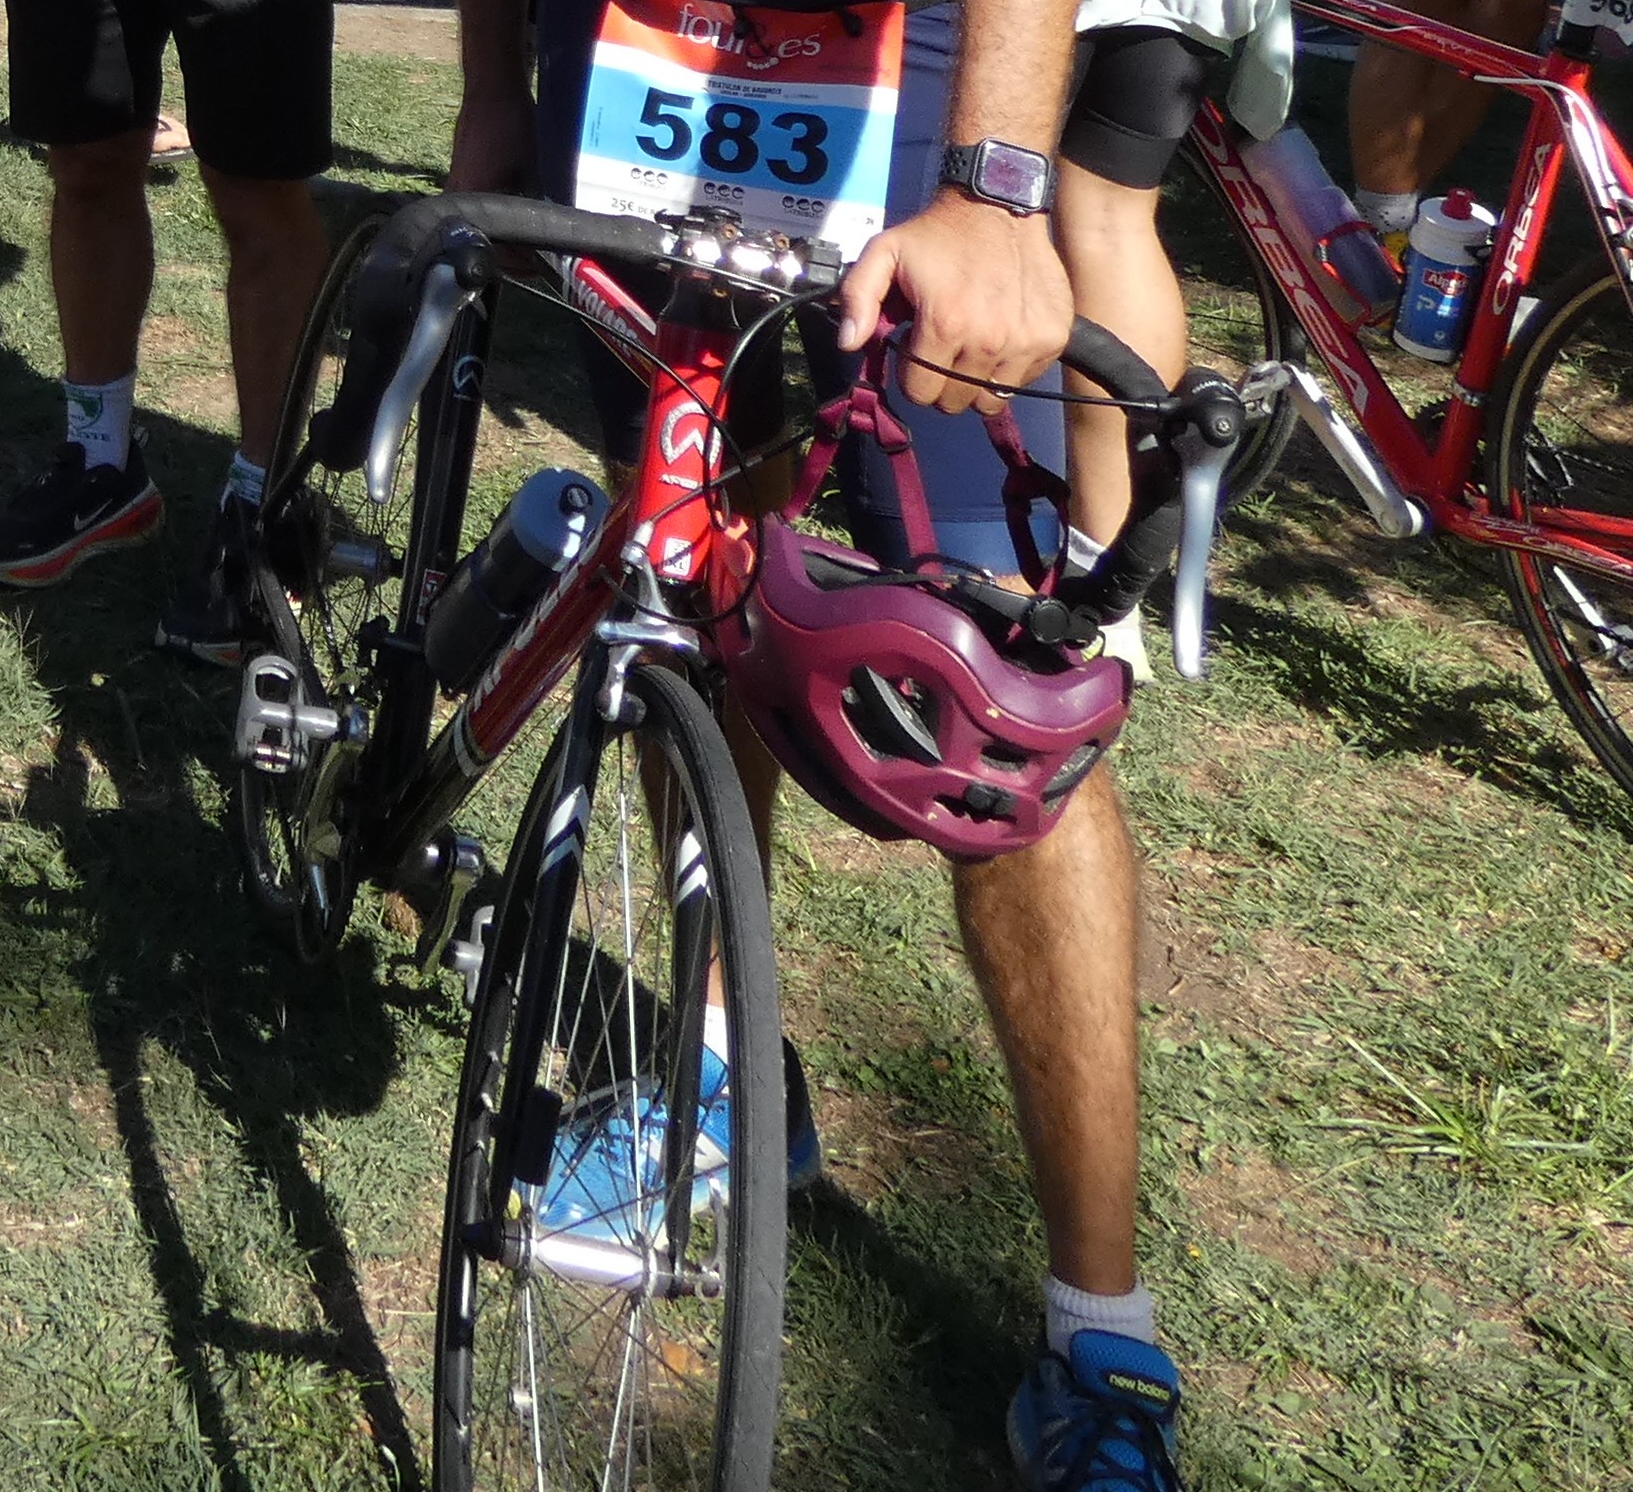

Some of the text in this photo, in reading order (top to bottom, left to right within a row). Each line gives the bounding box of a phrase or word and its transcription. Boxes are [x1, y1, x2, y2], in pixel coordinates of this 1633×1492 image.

[635, 87, 830, 186] 583
[611, 195, 635, 212] 25€
[1492, 143, 1553, 316] ORBEA
